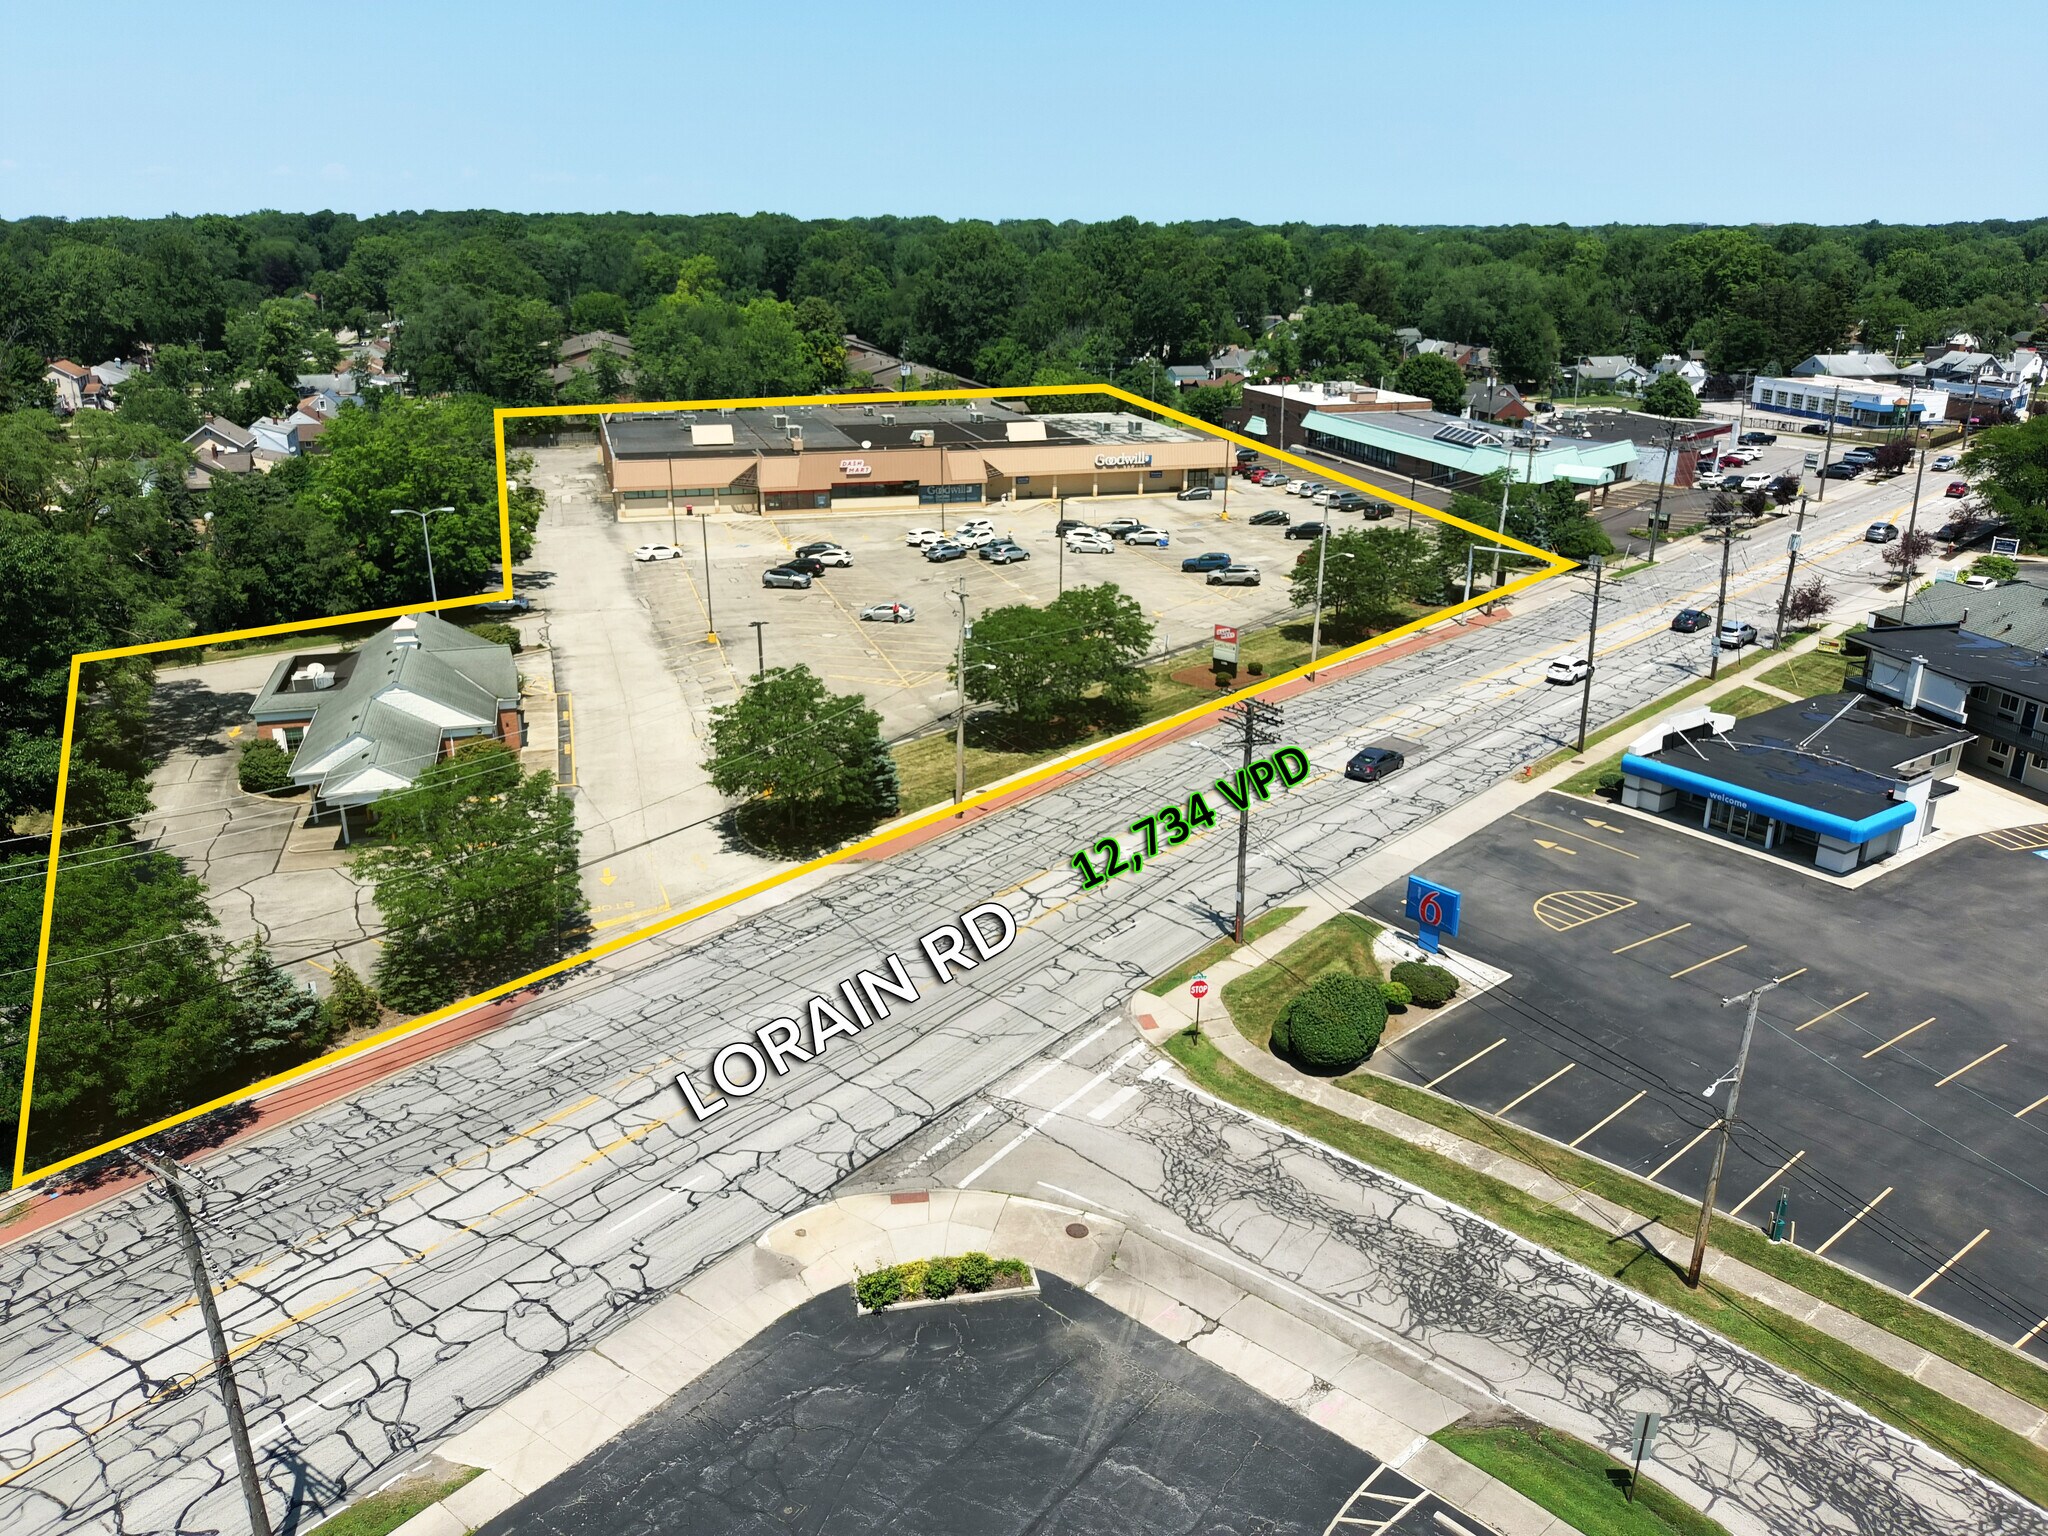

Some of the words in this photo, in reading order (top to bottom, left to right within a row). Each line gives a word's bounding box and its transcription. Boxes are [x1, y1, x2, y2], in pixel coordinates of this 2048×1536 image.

[1095, 451, 1146, 466] Goodwill
[926, 484, 966, 495] Goodwill
[1709, 791, 1748, 809] welcome
[1419, 891, 1442, 927] 6
[1190, 985, 1208, 994] STOP
